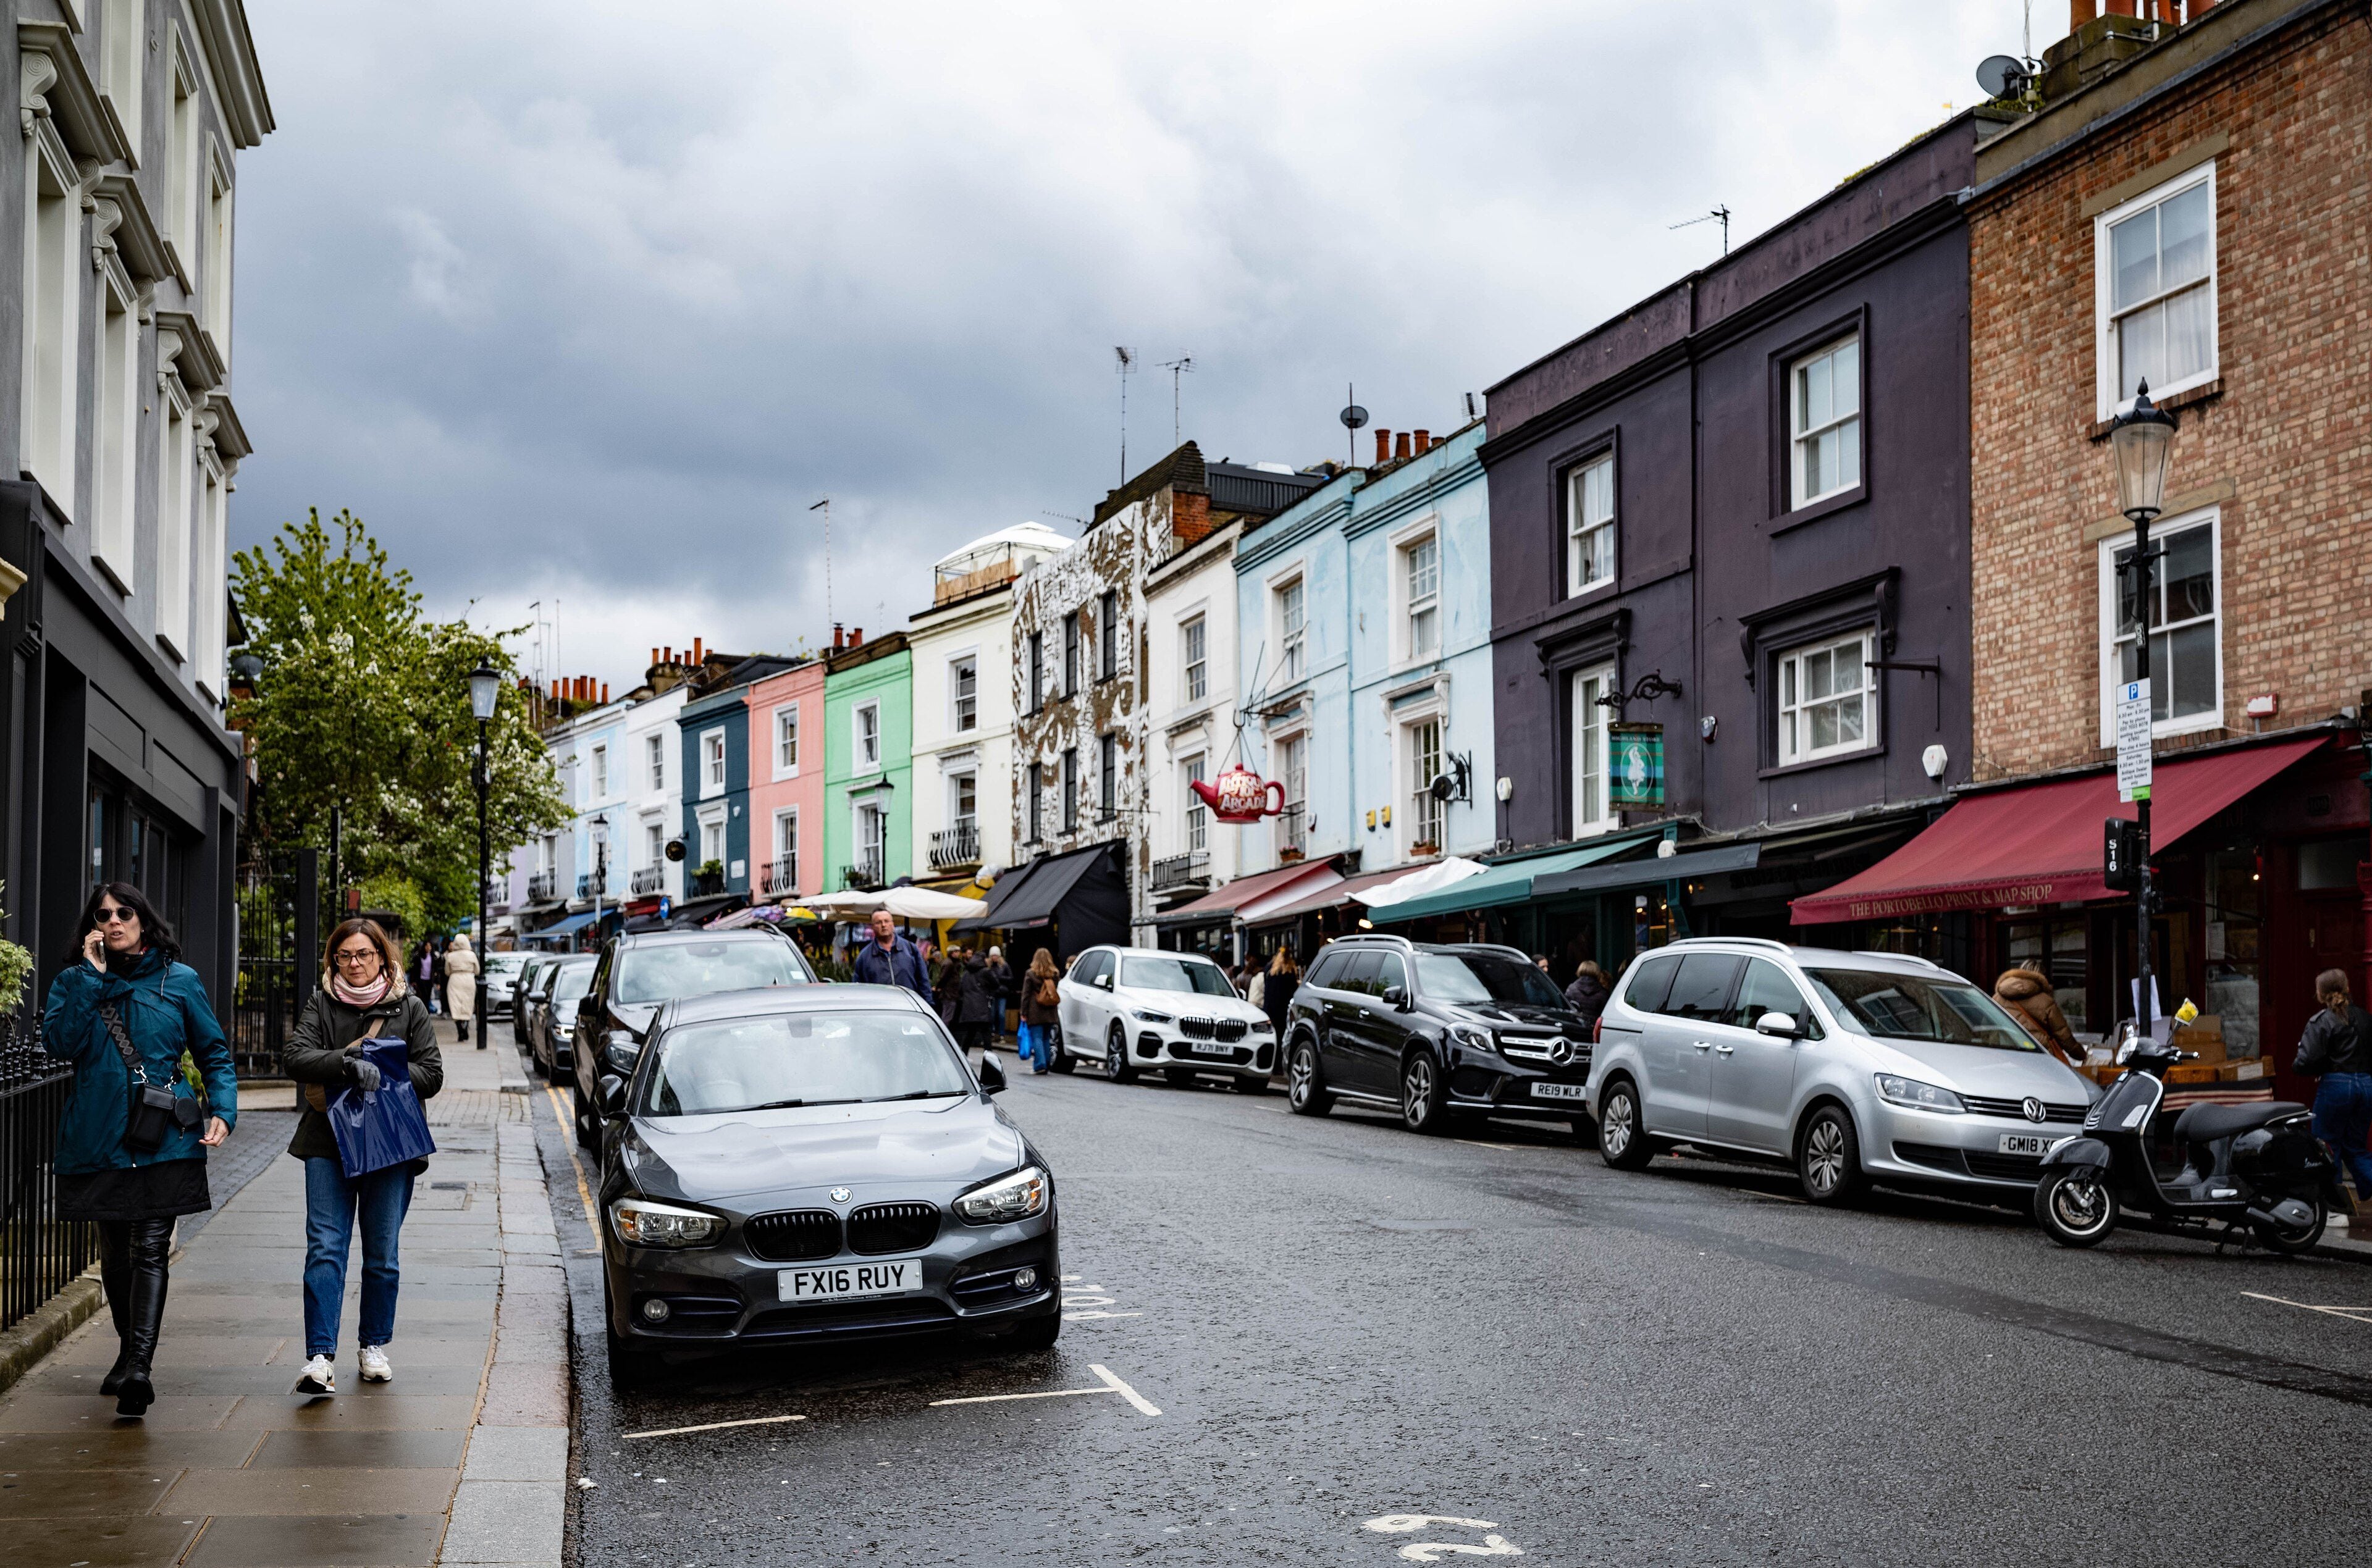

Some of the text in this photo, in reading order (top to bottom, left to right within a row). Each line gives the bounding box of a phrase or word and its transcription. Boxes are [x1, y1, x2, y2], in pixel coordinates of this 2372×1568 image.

[2109, 839, 2118, 872] S16
[1849, 884, 2053, 917] THE PORTOBELLO PRINT & MAP SHOP
[1538, 1084, 1581, 1097] RE19 WLR
[2008, 1137, 2038, 1152] GM18
[794, 1264, 904, 1296] FX16 RUY
